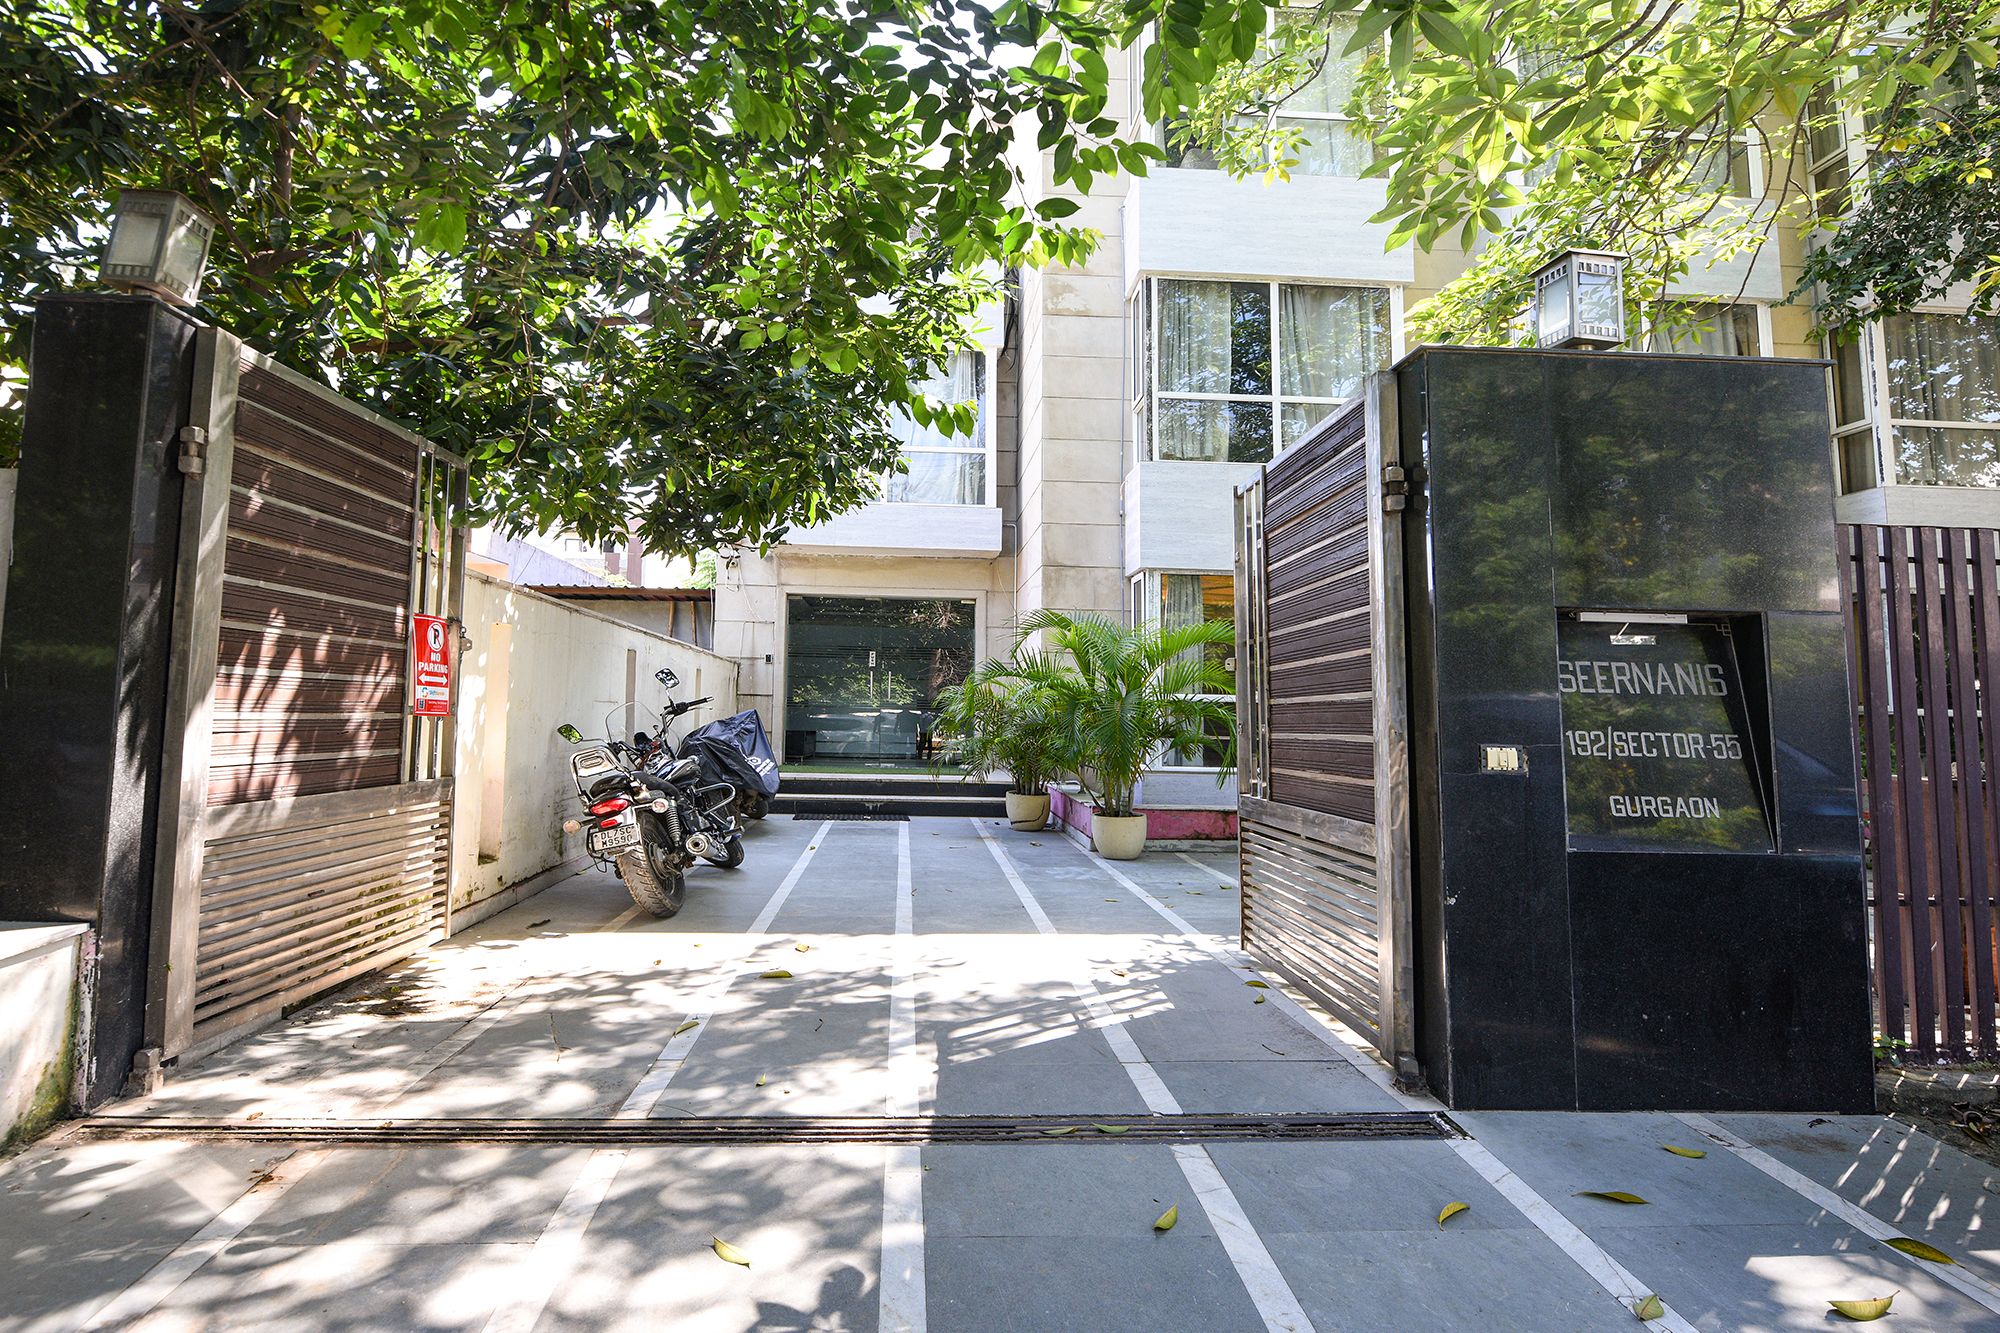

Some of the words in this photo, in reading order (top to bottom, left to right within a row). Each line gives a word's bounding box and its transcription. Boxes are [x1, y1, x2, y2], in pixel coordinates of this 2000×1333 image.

[418, 661, 448, 674] PARKING
[430, 652, 441, 662] NO
[1558, 661, 1728, 697] SEERNANIS
[1565, 726, 1743, 760] 192/SECTOR-55
[1609, 795, 1720, 819] GURGAON
